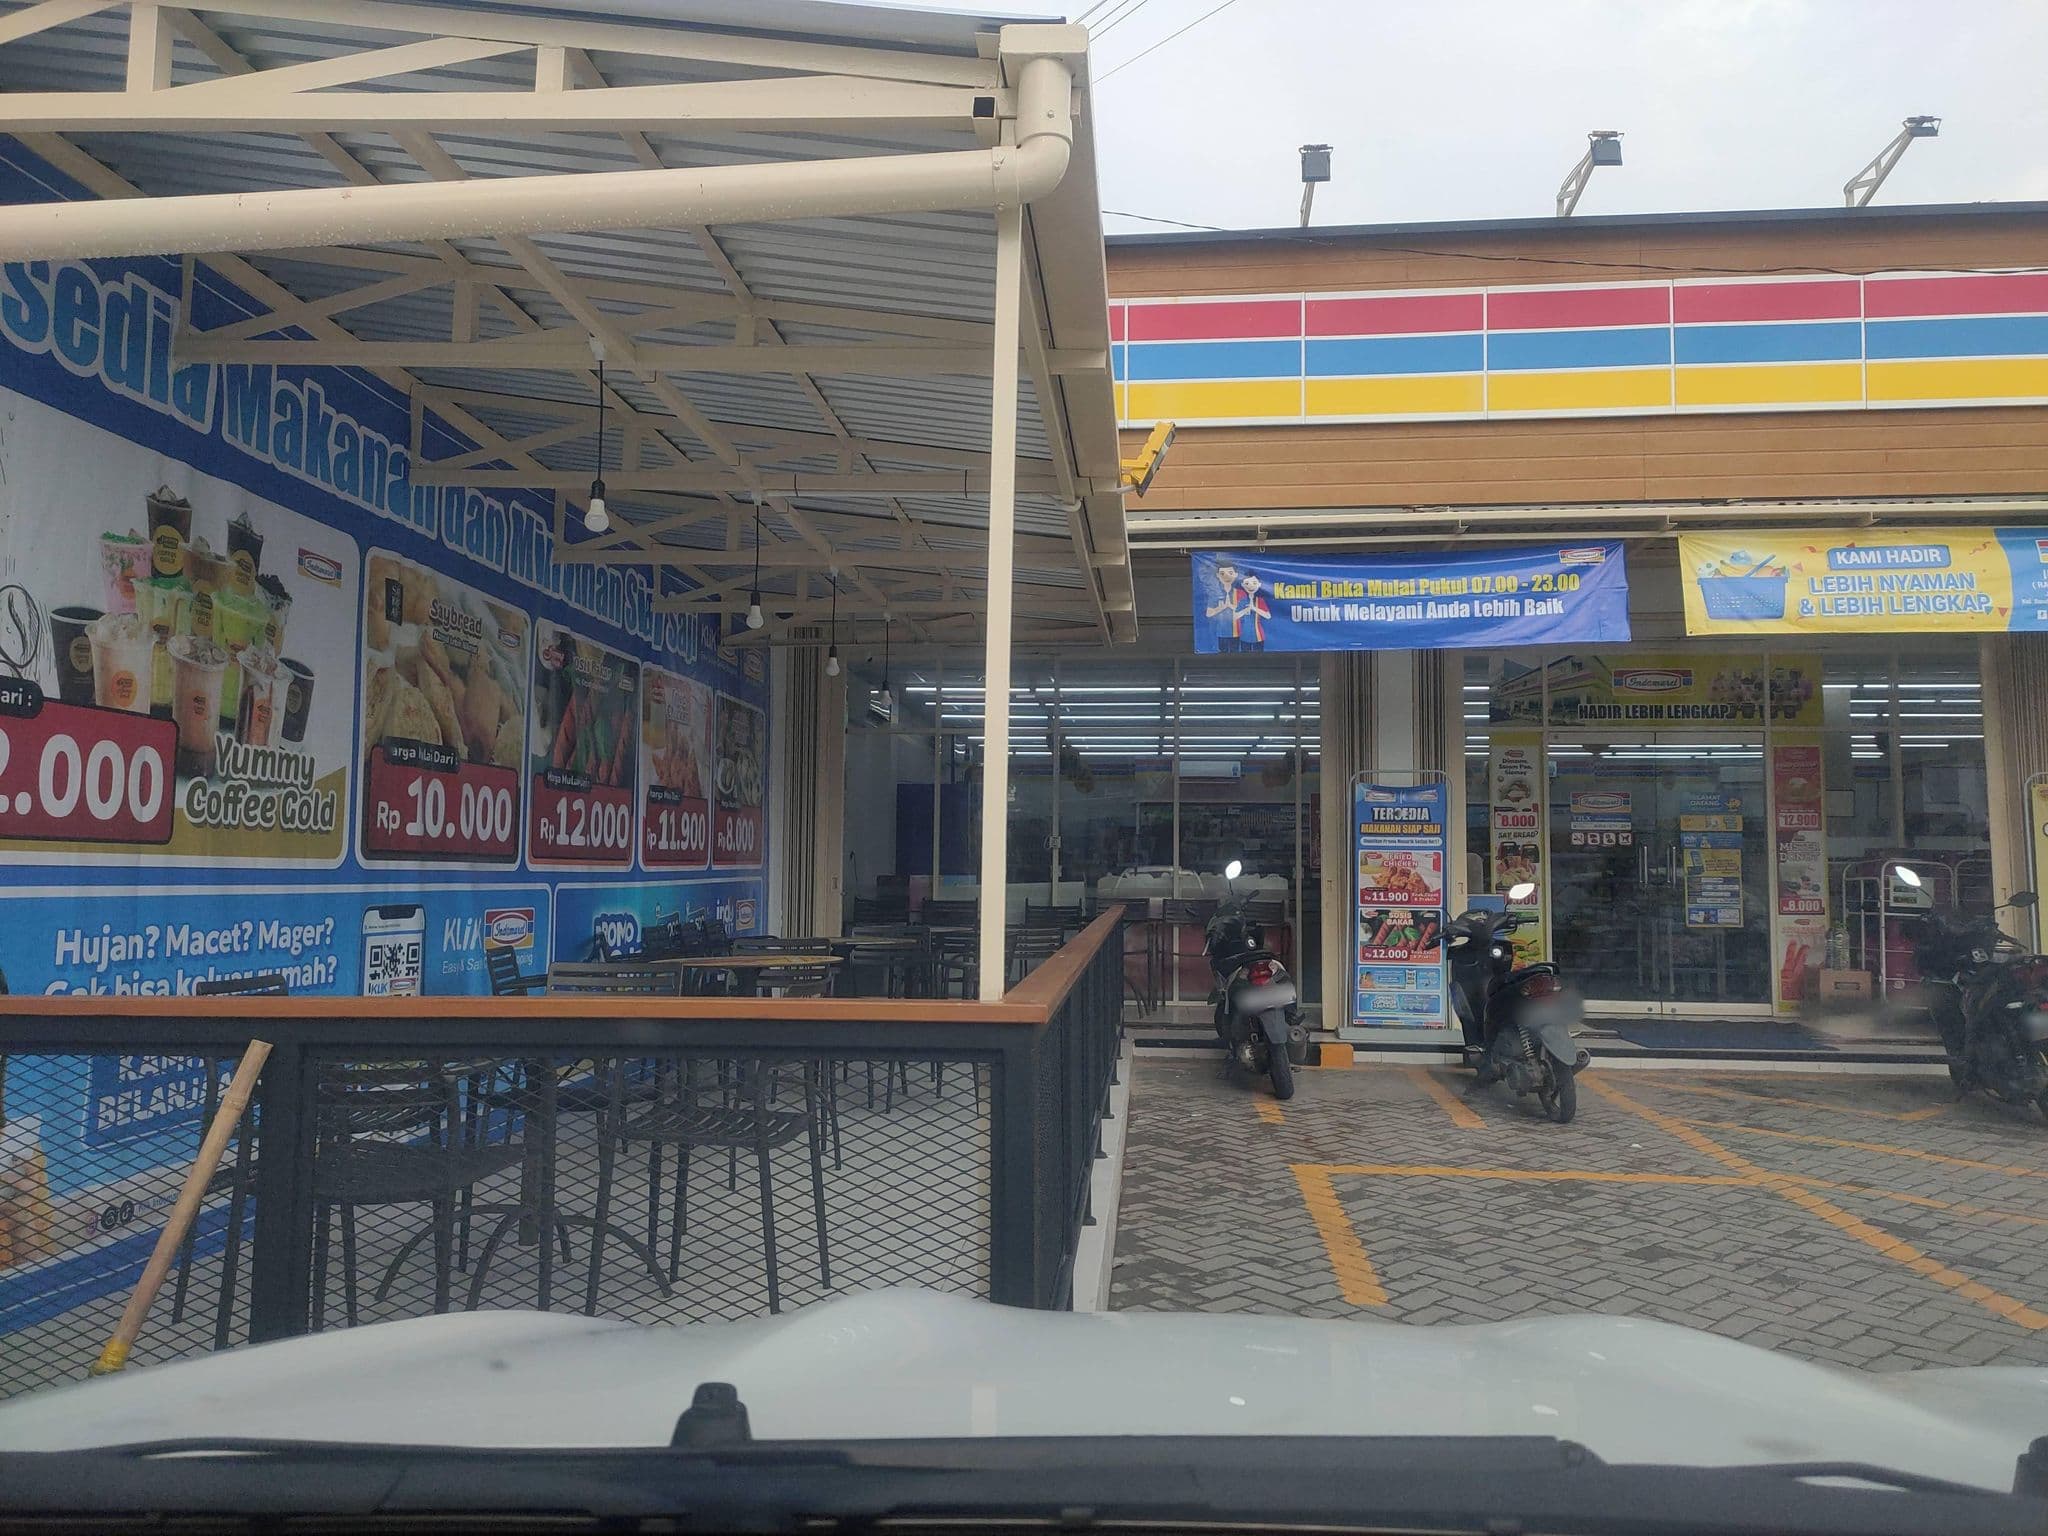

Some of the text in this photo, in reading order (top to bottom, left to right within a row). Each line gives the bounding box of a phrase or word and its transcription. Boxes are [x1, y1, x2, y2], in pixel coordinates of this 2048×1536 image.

[0, 259, 217, 436] Sedia
[1835, 548, 1942, 565] KAMI HADIR
[1273, 582, 1317, 600] Kami
[1320, 580, 1363, 598] Buka
[1366, 579, 1415, 598] Mulai
[1418, 577, 1468, 596] Pukul
[1471, 575, 1519, 594] 07.00
[1531, 573, 1581, 593] 23.00
[1808, 572, 1976, 595] LEBIH NYAMAN
[1291, 598, 1565, 623] Untuk Melayani Anda Lebih Baik
[1799, 592, 1993, 615] & LEBIH LENGKAP
[1627, 677, 1678, 688] Indomaret
[1578, 704, 1729, 720] HADIR LEBIH LENGKAP
[216, 733, 315, 793] Yummy
[0, 728, 164, 823] .000
[186, 778, 336, 830] Coffee Gold
[377, 776, 512, 842] Rp 10.000
[540, 797, 630, 849] Rp 12.000
[658, 809, 706, 850] 11.900
[1402, 824, 1422, 834] SIAP
[1383, 860, 1419, 868] CHICKEN
[1371, 892, 1409, 902] 11.900
[1386, 918, 1414, 926] BAKAR
[55, 916, 335, 972] Hujan? Macet? Mager?
[1371, 949, 1408, 959] 12.000
